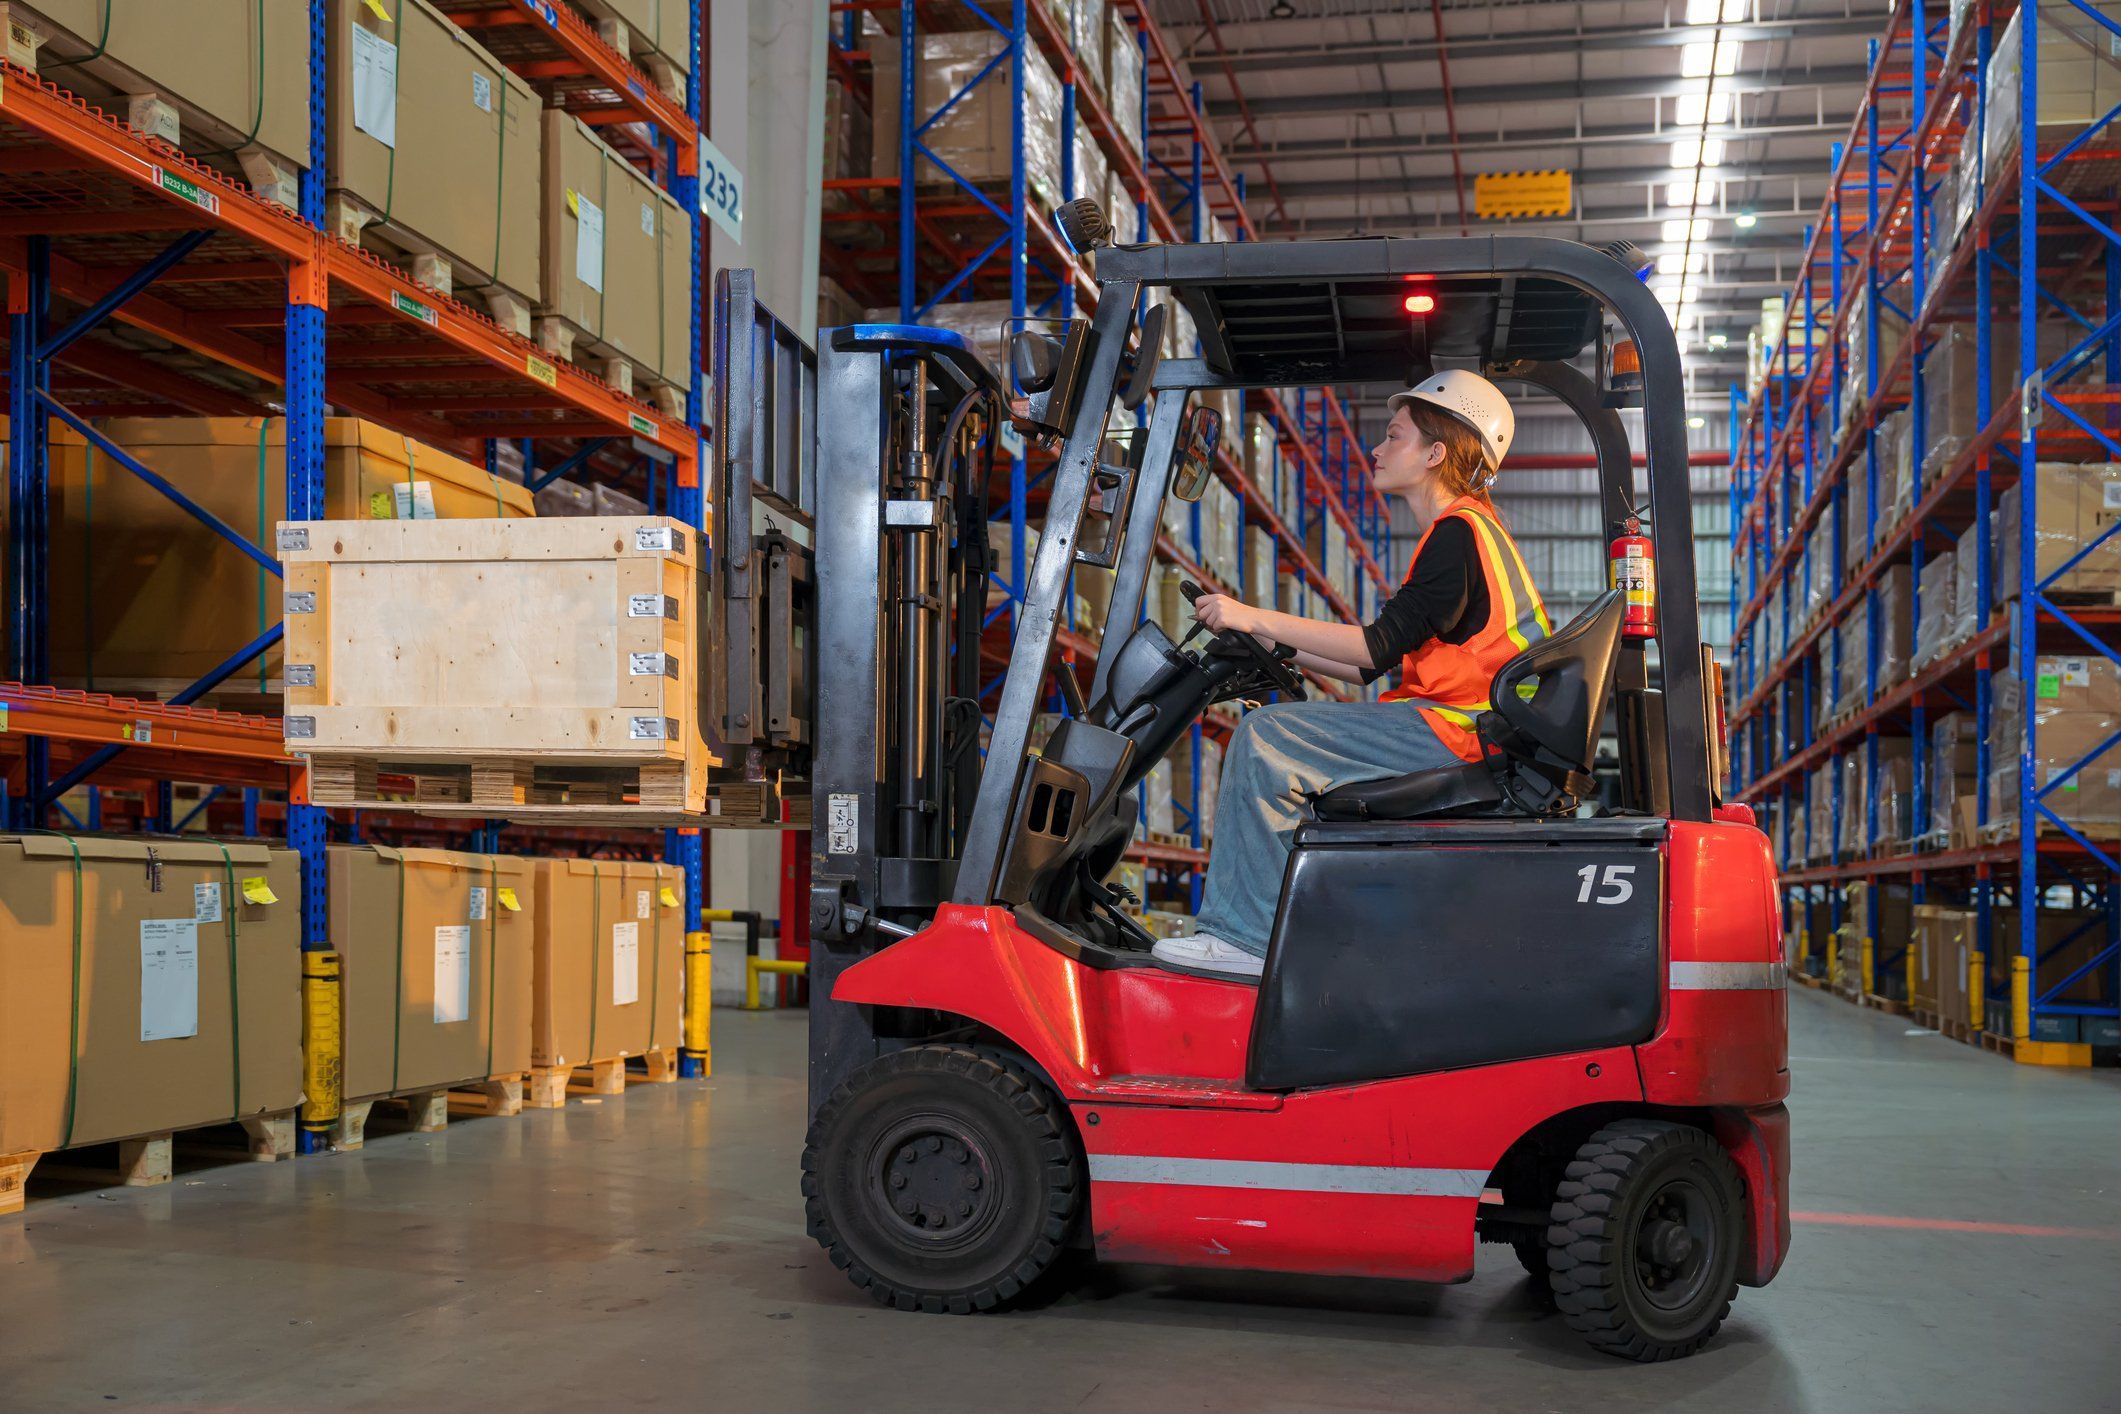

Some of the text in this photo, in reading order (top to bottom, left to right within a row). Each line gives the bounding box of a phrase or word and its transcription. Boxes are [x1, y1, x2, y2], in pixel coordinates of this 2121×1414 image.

[164, 175, 181, 191] B232
[705, 160, 739, 222] 232
[1577, 864, 1636, 905] 15
